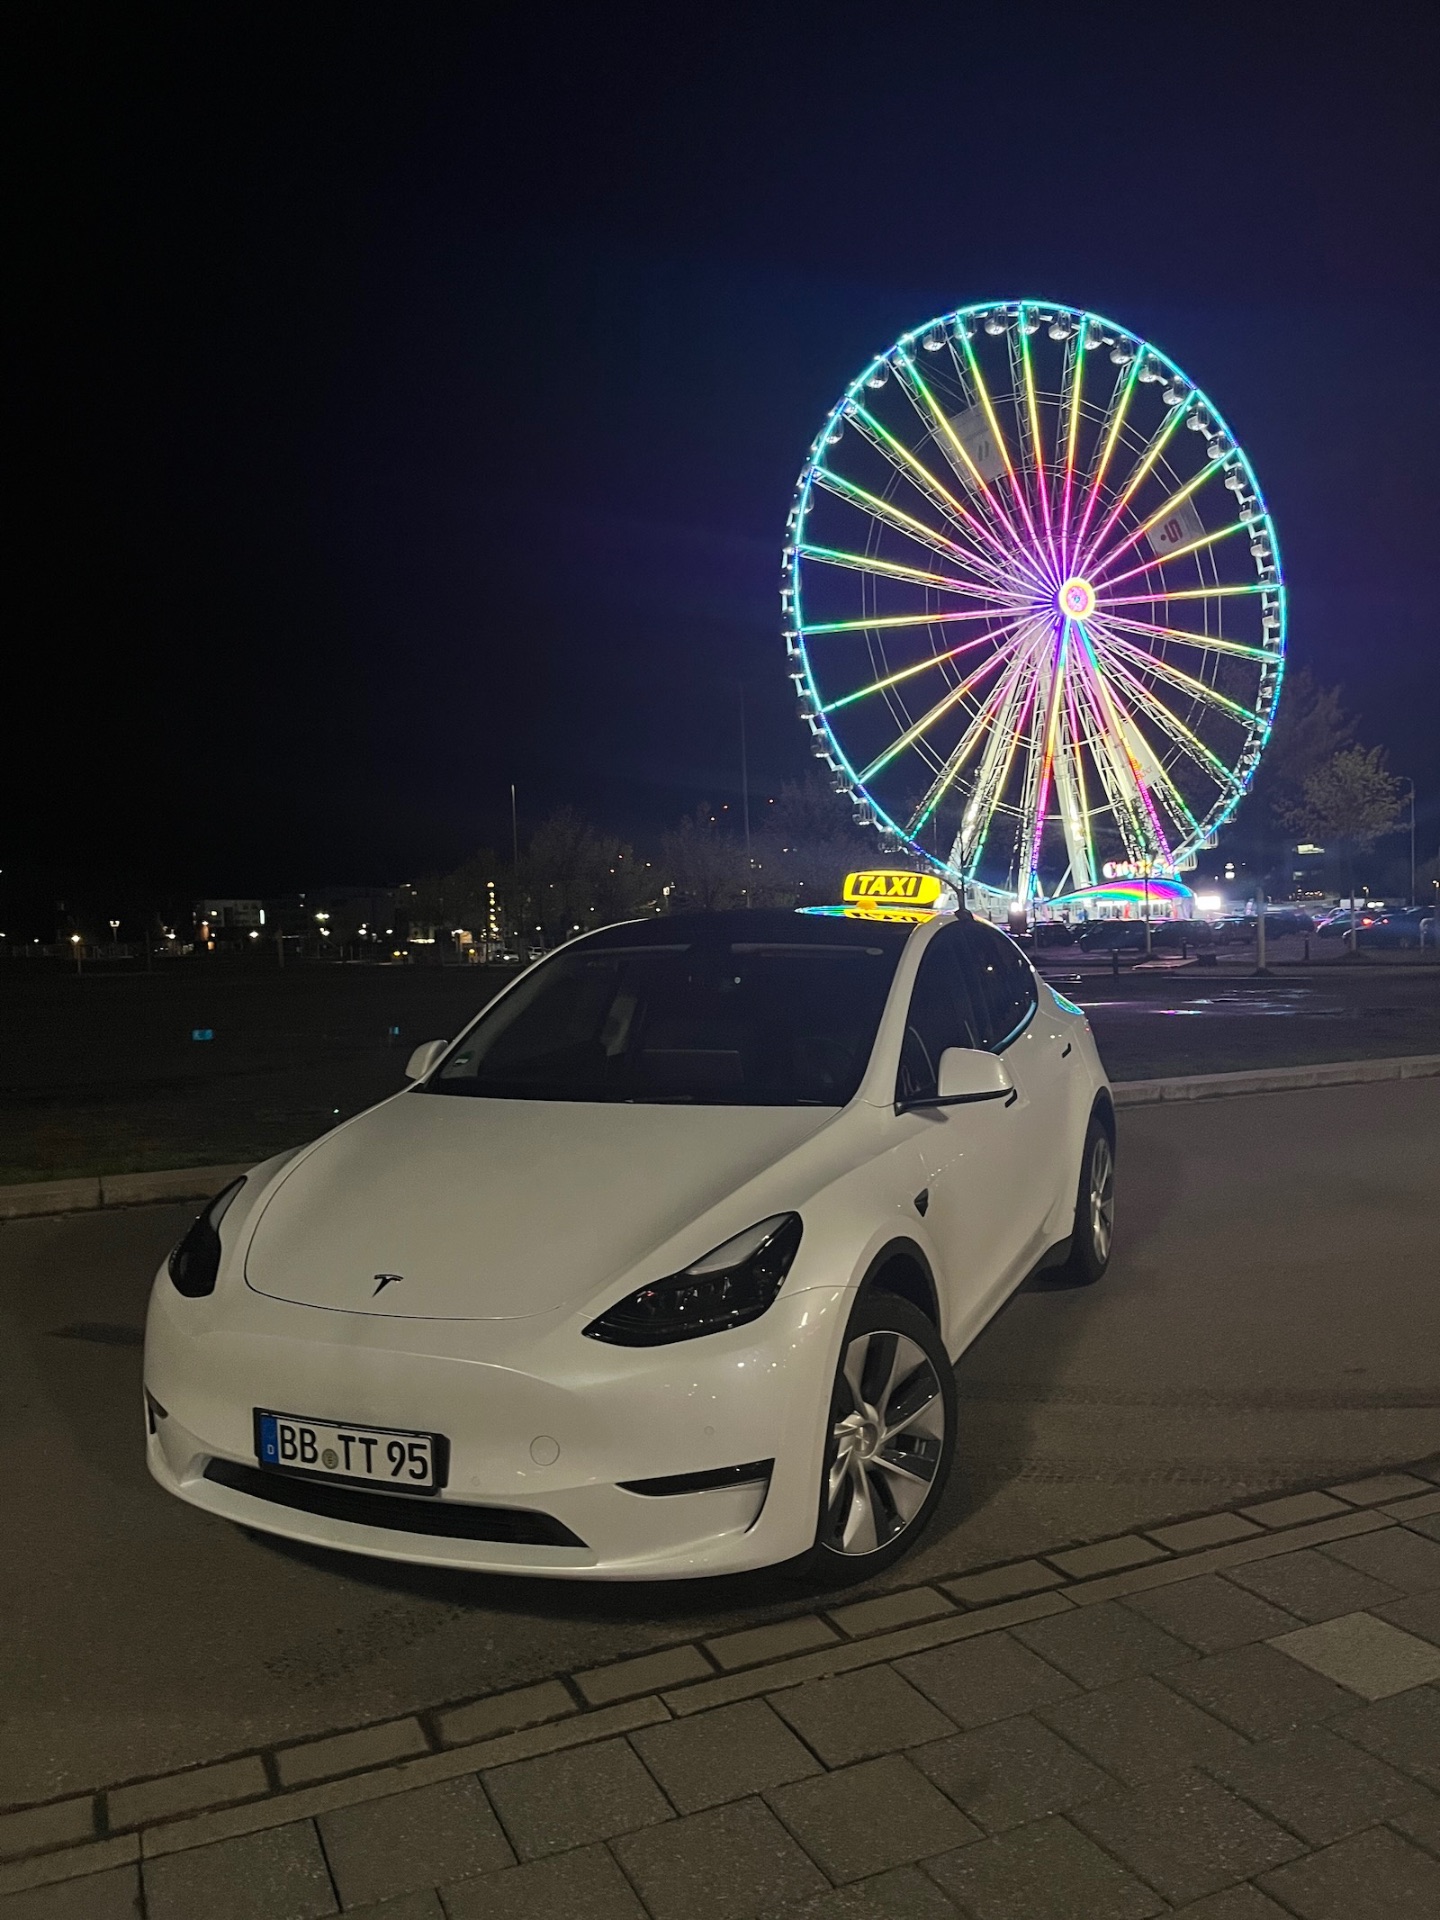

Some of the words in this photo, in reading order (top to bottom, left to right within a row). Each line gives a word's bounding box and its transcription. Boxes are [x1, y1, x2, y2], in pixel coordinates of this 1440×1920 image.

[858, 875, 917, 896] TAXI
[280, 1424, 318, 1464] BB
[337, 1434, 378, 1474] TT
[386, 1441, 428, 1480] 95
